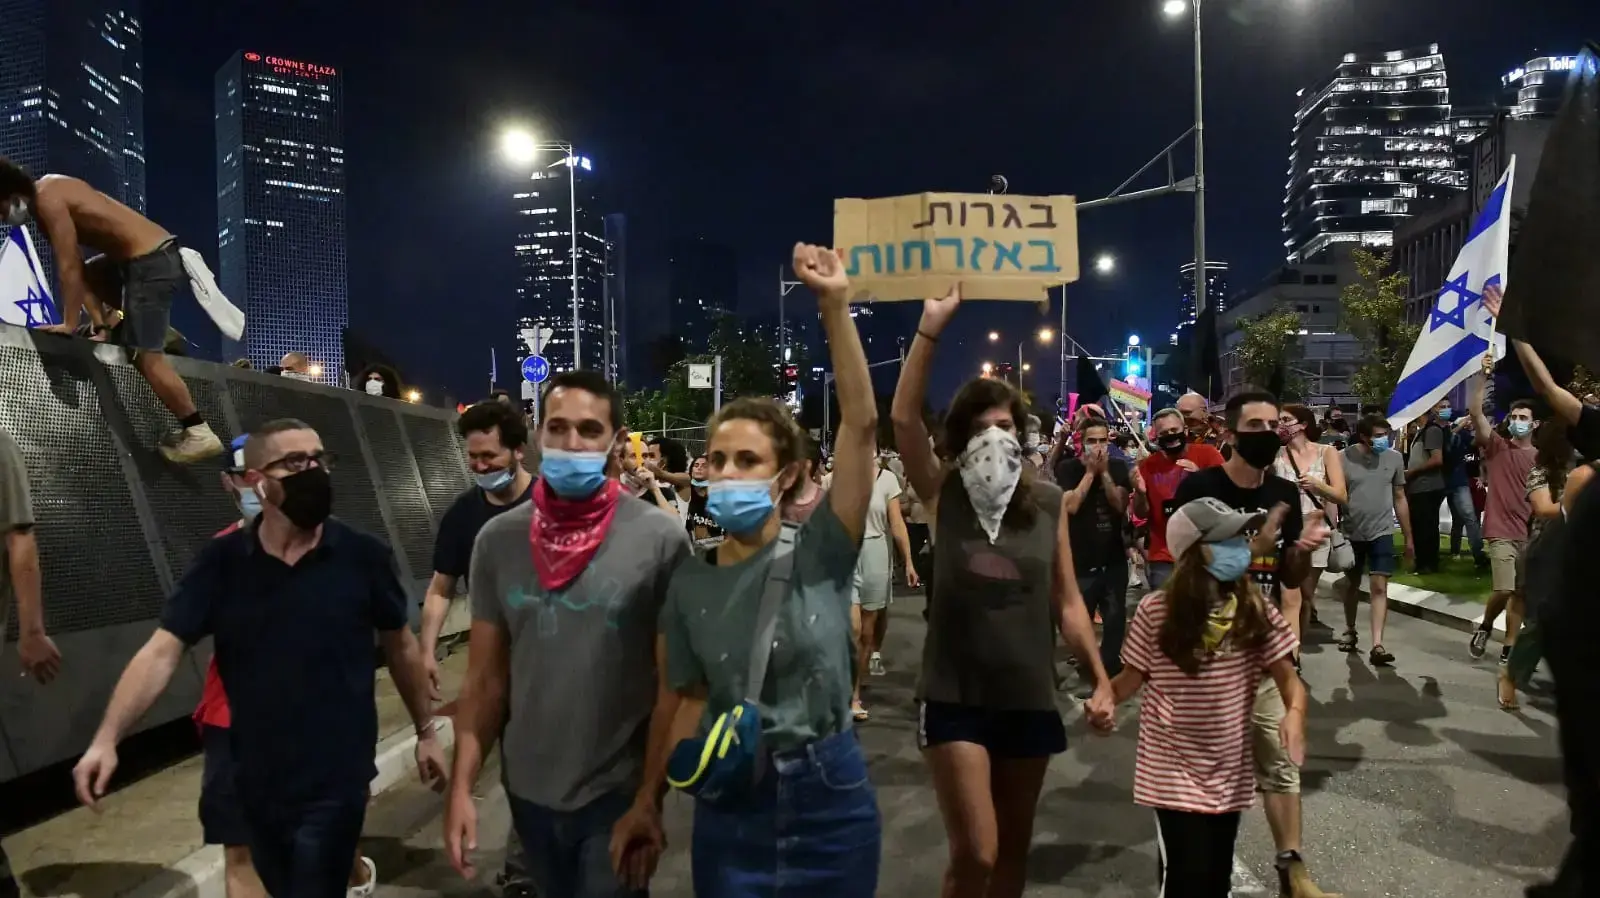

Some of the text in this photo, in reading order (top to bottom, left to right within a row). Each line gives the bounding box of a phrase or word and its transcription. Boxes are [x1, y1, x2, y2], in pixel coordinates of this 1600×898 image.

[266, 57, 336, 75] CROWNE PLAZA
[912, 200, 1058, 230] בגרות
[846, 237, 1061, 275] באזרחות
